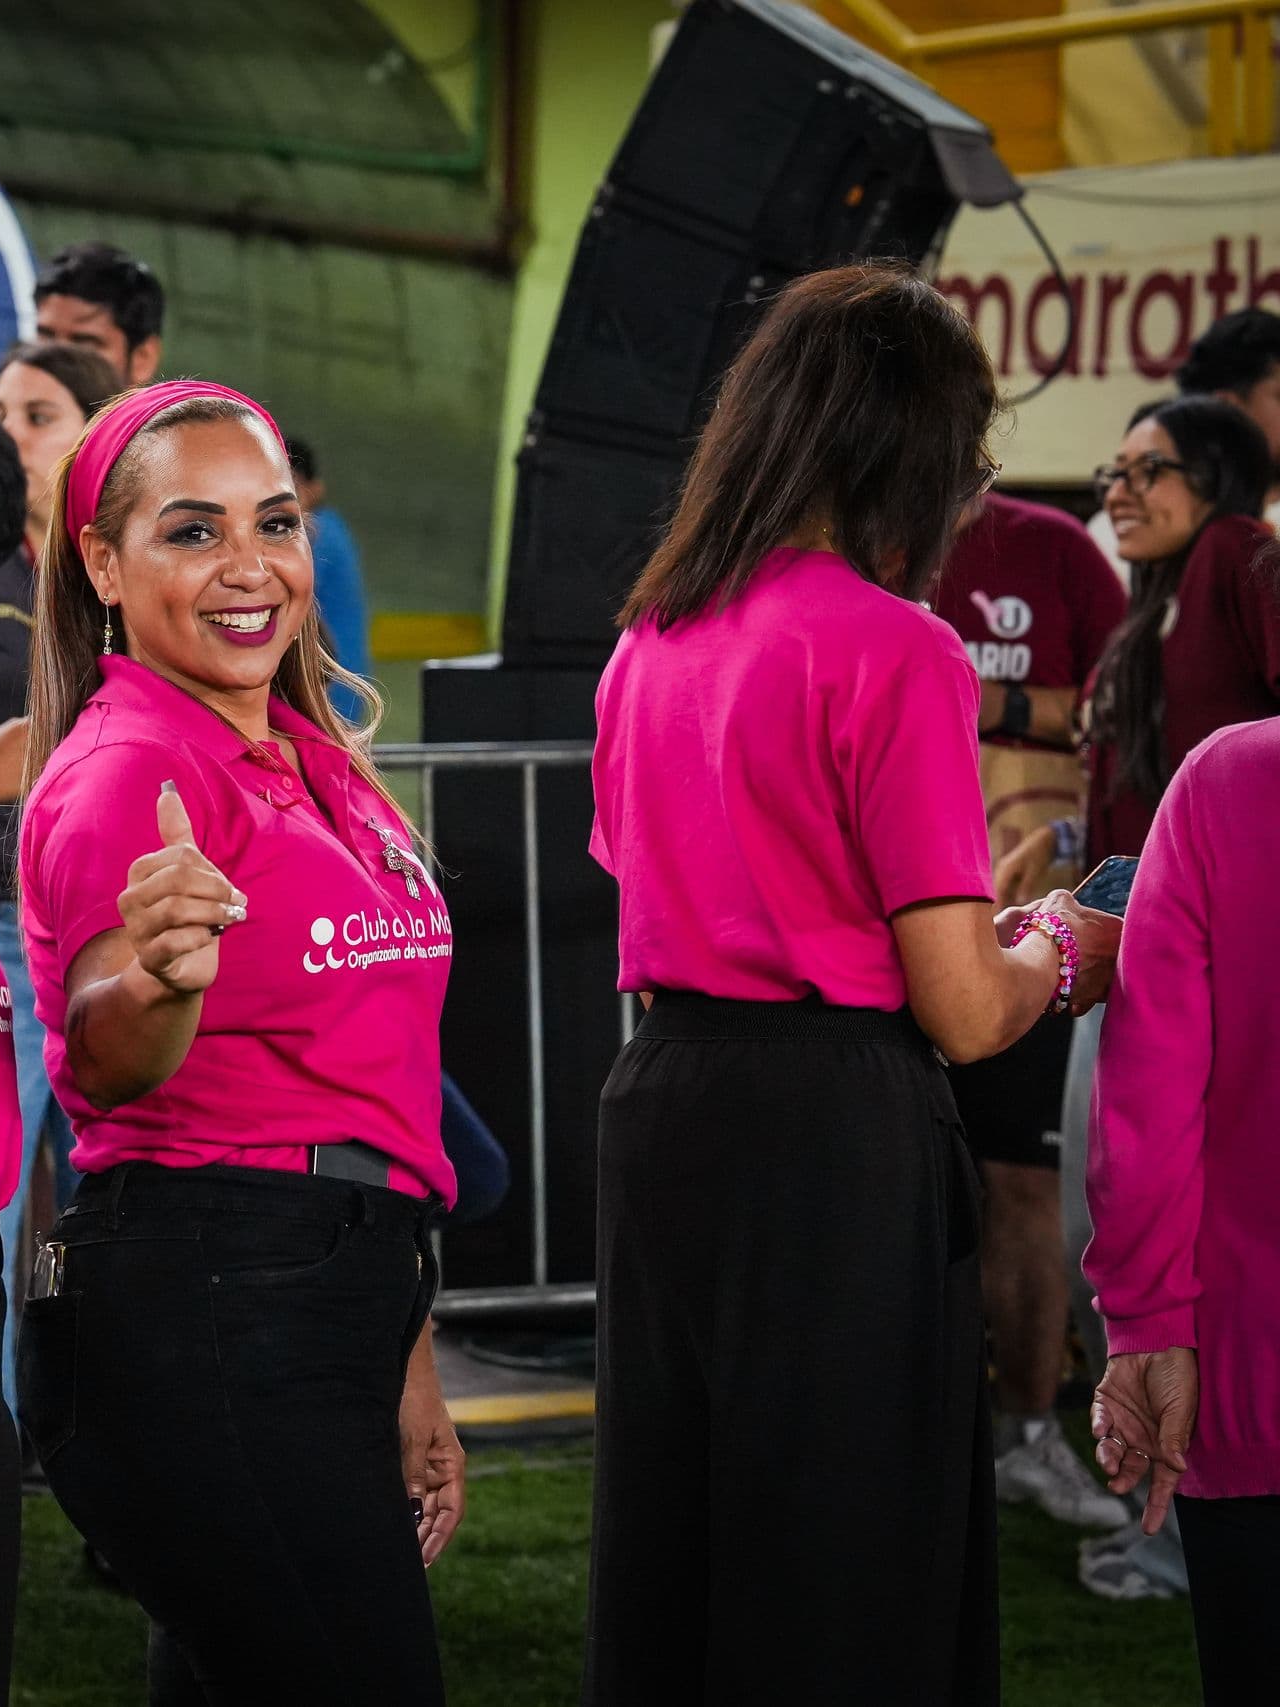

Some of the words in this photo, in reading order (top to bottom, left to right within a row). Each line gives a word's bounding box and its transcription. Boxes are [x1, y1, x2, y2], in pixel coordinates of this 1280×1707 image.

[343, 908, 388, 946] Club
[406, 909, 426, 939] la
[404, 941, 416, 959] de
